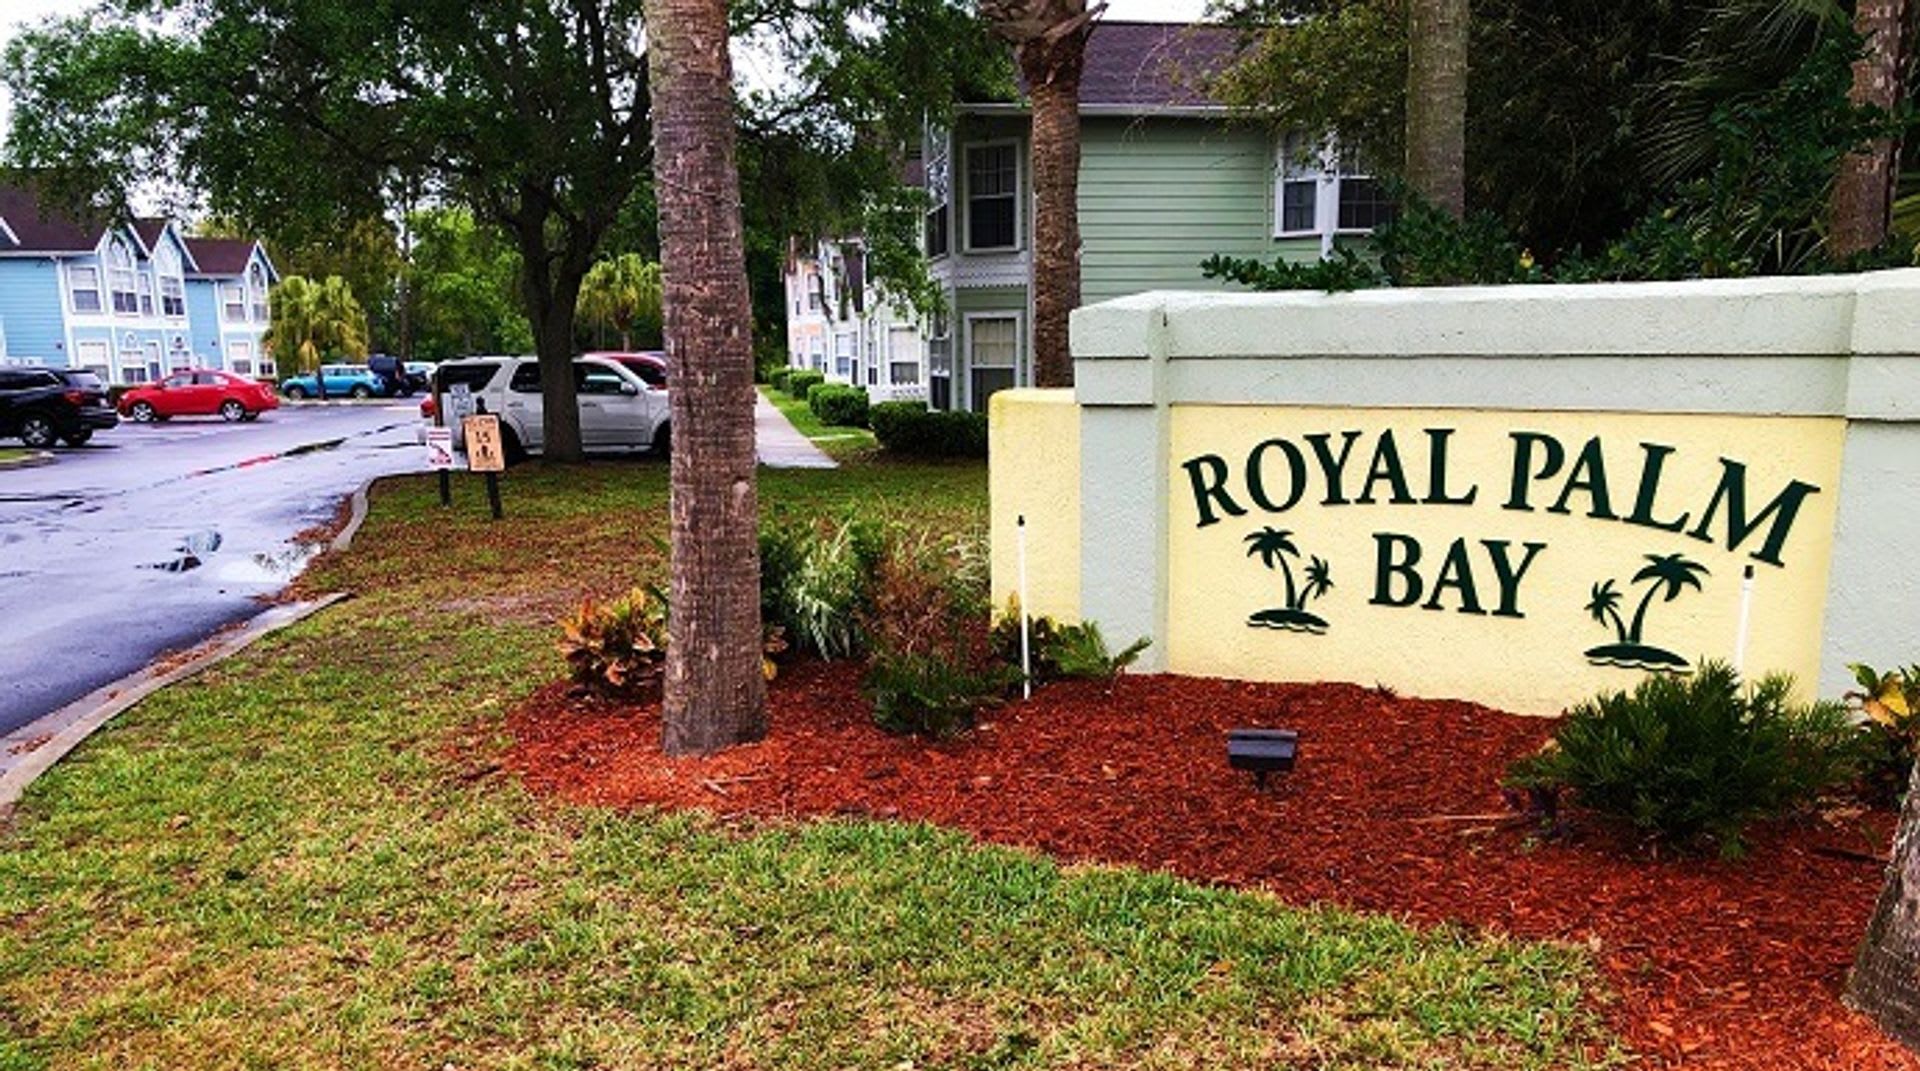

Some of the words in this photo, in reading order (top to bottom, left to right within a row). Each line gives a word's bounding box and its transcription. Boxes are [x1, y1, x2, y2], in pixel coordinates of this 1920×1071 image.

[1182, 428, 1478, 528] ROYAL
[1501, 432, 1821, 568] PALM
[1368, 532, 1547, 619] BAY
